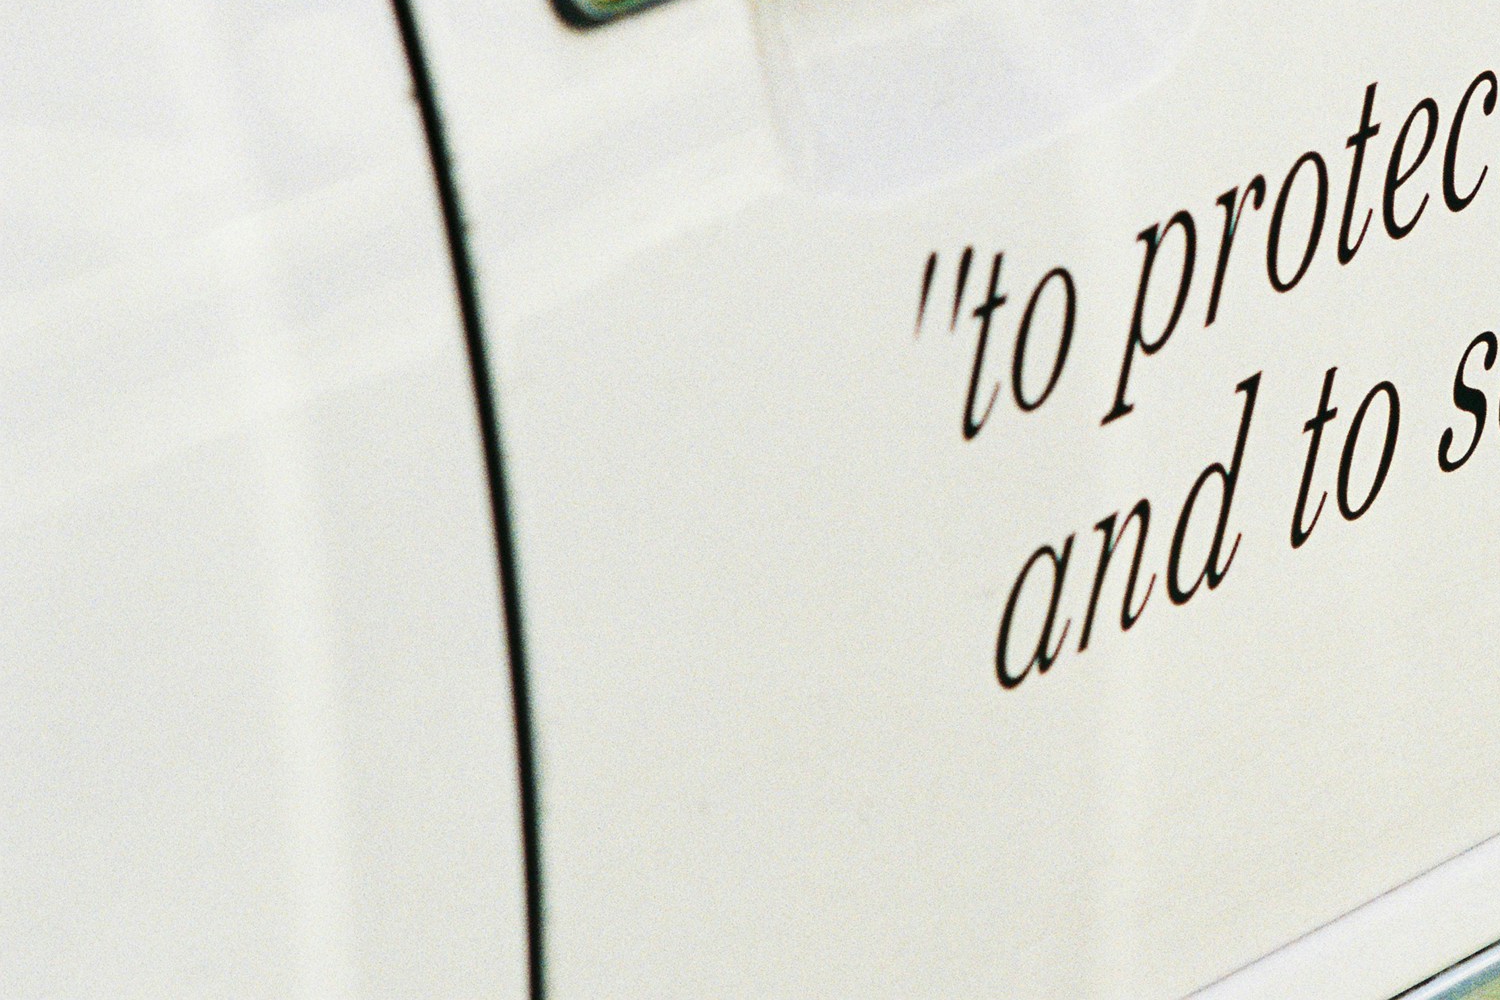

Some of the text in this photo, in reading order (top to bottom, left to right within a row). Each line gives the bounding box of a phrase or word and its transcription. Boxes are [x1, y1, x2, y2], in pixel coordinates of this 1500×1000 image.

[914, 246, 1078, 440] "to
[994, 370, 1262, 690] and
[1290, 366, 1400, 549] to
